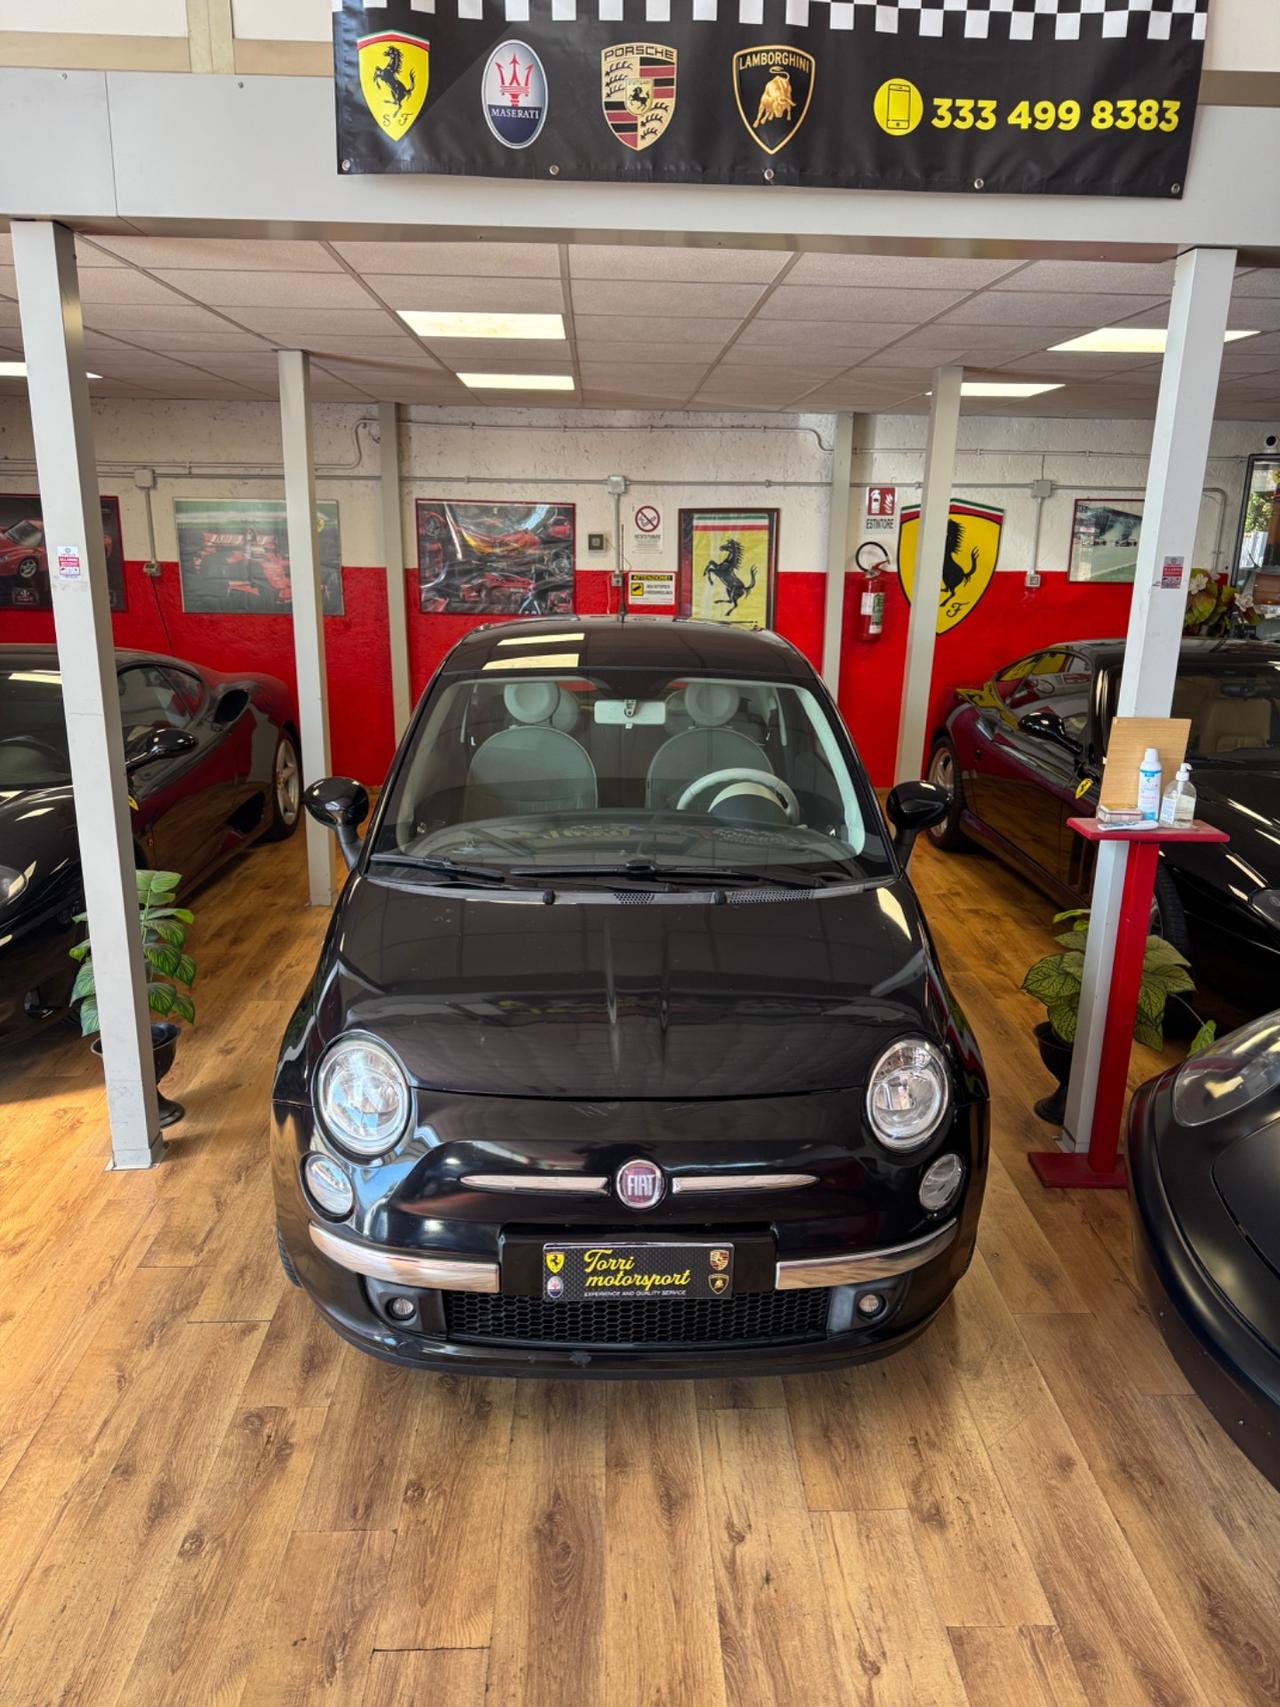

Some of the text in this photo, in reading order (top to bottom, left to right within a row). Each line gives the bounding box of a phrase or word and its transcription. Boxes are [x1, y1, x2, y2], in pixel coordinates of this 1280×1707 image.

[604, 45, 675, 61] PORSCHE
[739, 52, 809, 73] LAMBORGHINI
[491, 108, 540, 120] MASERATI
[931, 97, 1181, 132] 333 499 8383
[626, 1174, 656, 1196] FIAT
[583, 1249, 635, 1273] Torri
[585, 1269, 691, 1292] motorsport
